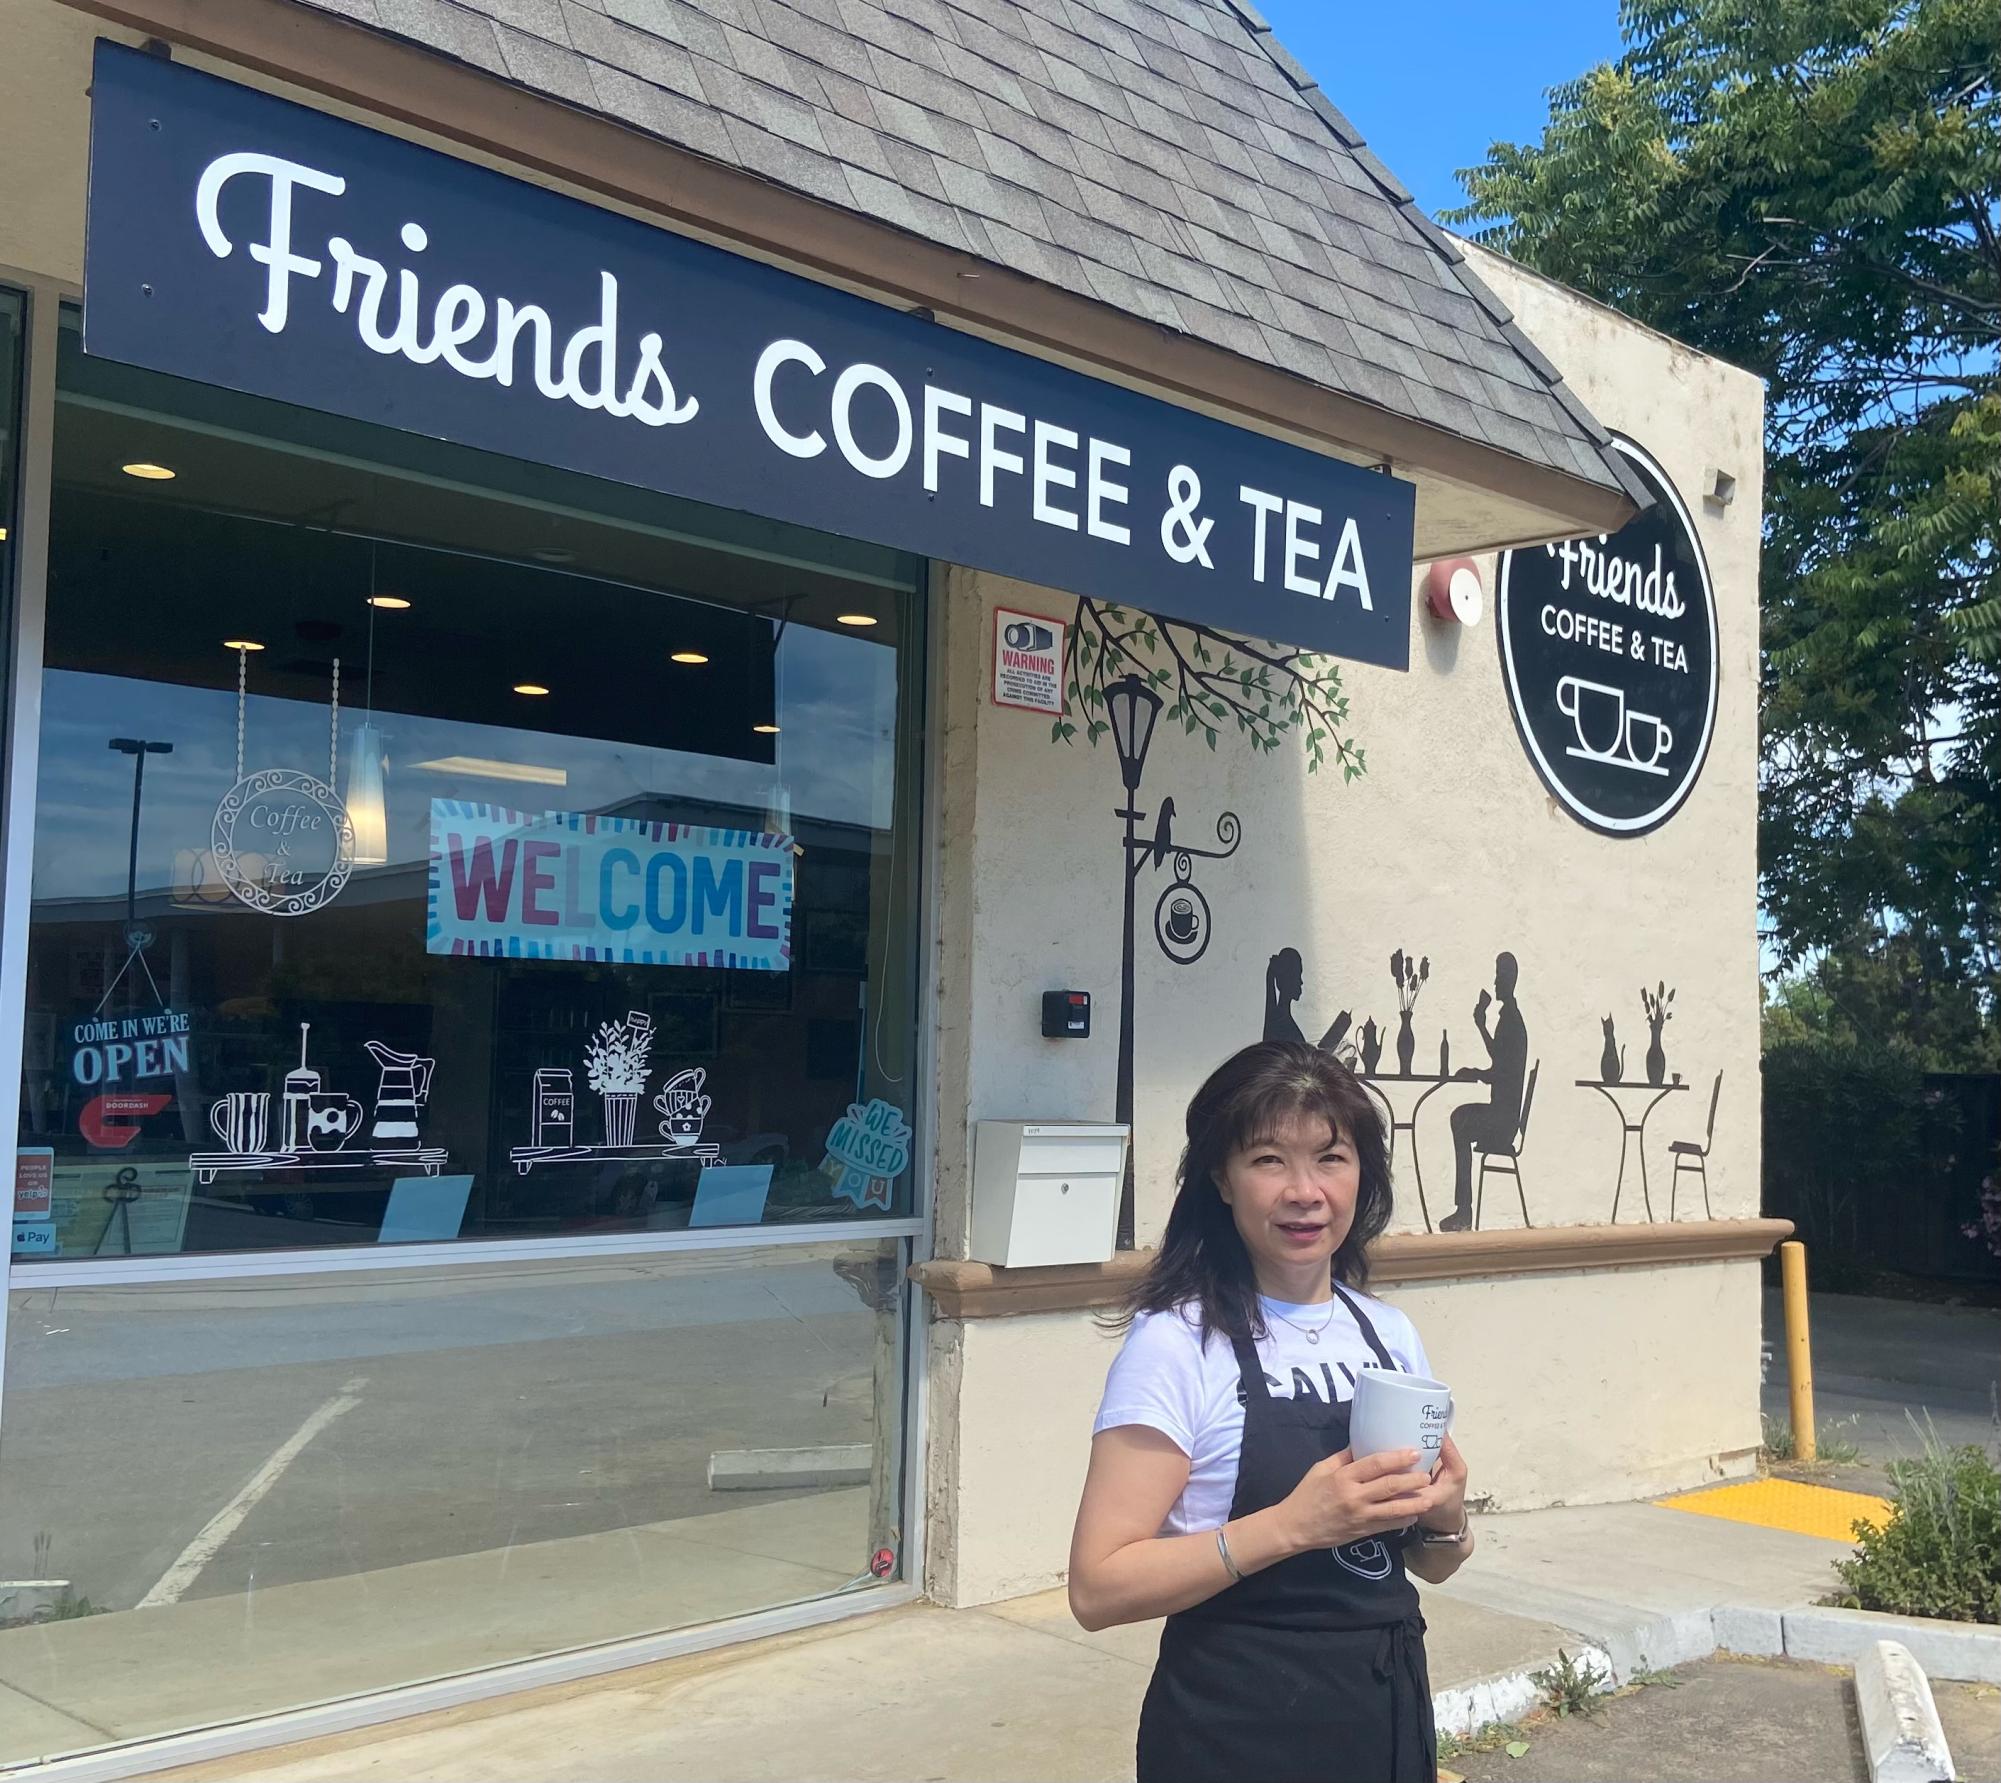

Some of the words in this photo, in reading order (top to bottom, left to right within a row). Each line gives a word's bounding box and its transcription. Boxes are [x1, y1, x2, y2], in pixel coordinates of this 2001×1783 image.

[195, 151, 699, 428] Friends
[753, 338, 1131, 547] COFFEE
[1159, 463, 1215, 571] &
[1239, 484, 1374, 612] TEA
[1540, 603, 1624, 656] COFFEE
[1629, 628, 1646, 662] &
[1650, 635, 1689, 674] TEA
[1002, 649, 1055, 675] WARNING
[1017, 670, 1041, 679] ACTIVITIES
[1003, 693, 1023, 701] AGAINST
[1035, 698, 1055, 706] FACILITY
[250, 805, 321, 835] Coffee
[276, 839, 292, 857] &
[264, 861, 304, 885] Tea
[447, 832, 781, 940] WELCOME
[74, 1020, 118, 1043] COME
[122, 1018, 138, 1037] IN
[142, 1013, 190, 1035] WE'RE
[73, 1035, 189, 1085] OPEN
[543, 1097, 570, 1106] COFFEE
[864, 1103, 898, 1136] WE
[830, 1121, 903, 1173] MISSED
[825, 1157, 885, 1195] YOU
[18, 1189, 38, 1200] yelp
[28, 1231, 50, 1245] Pay
